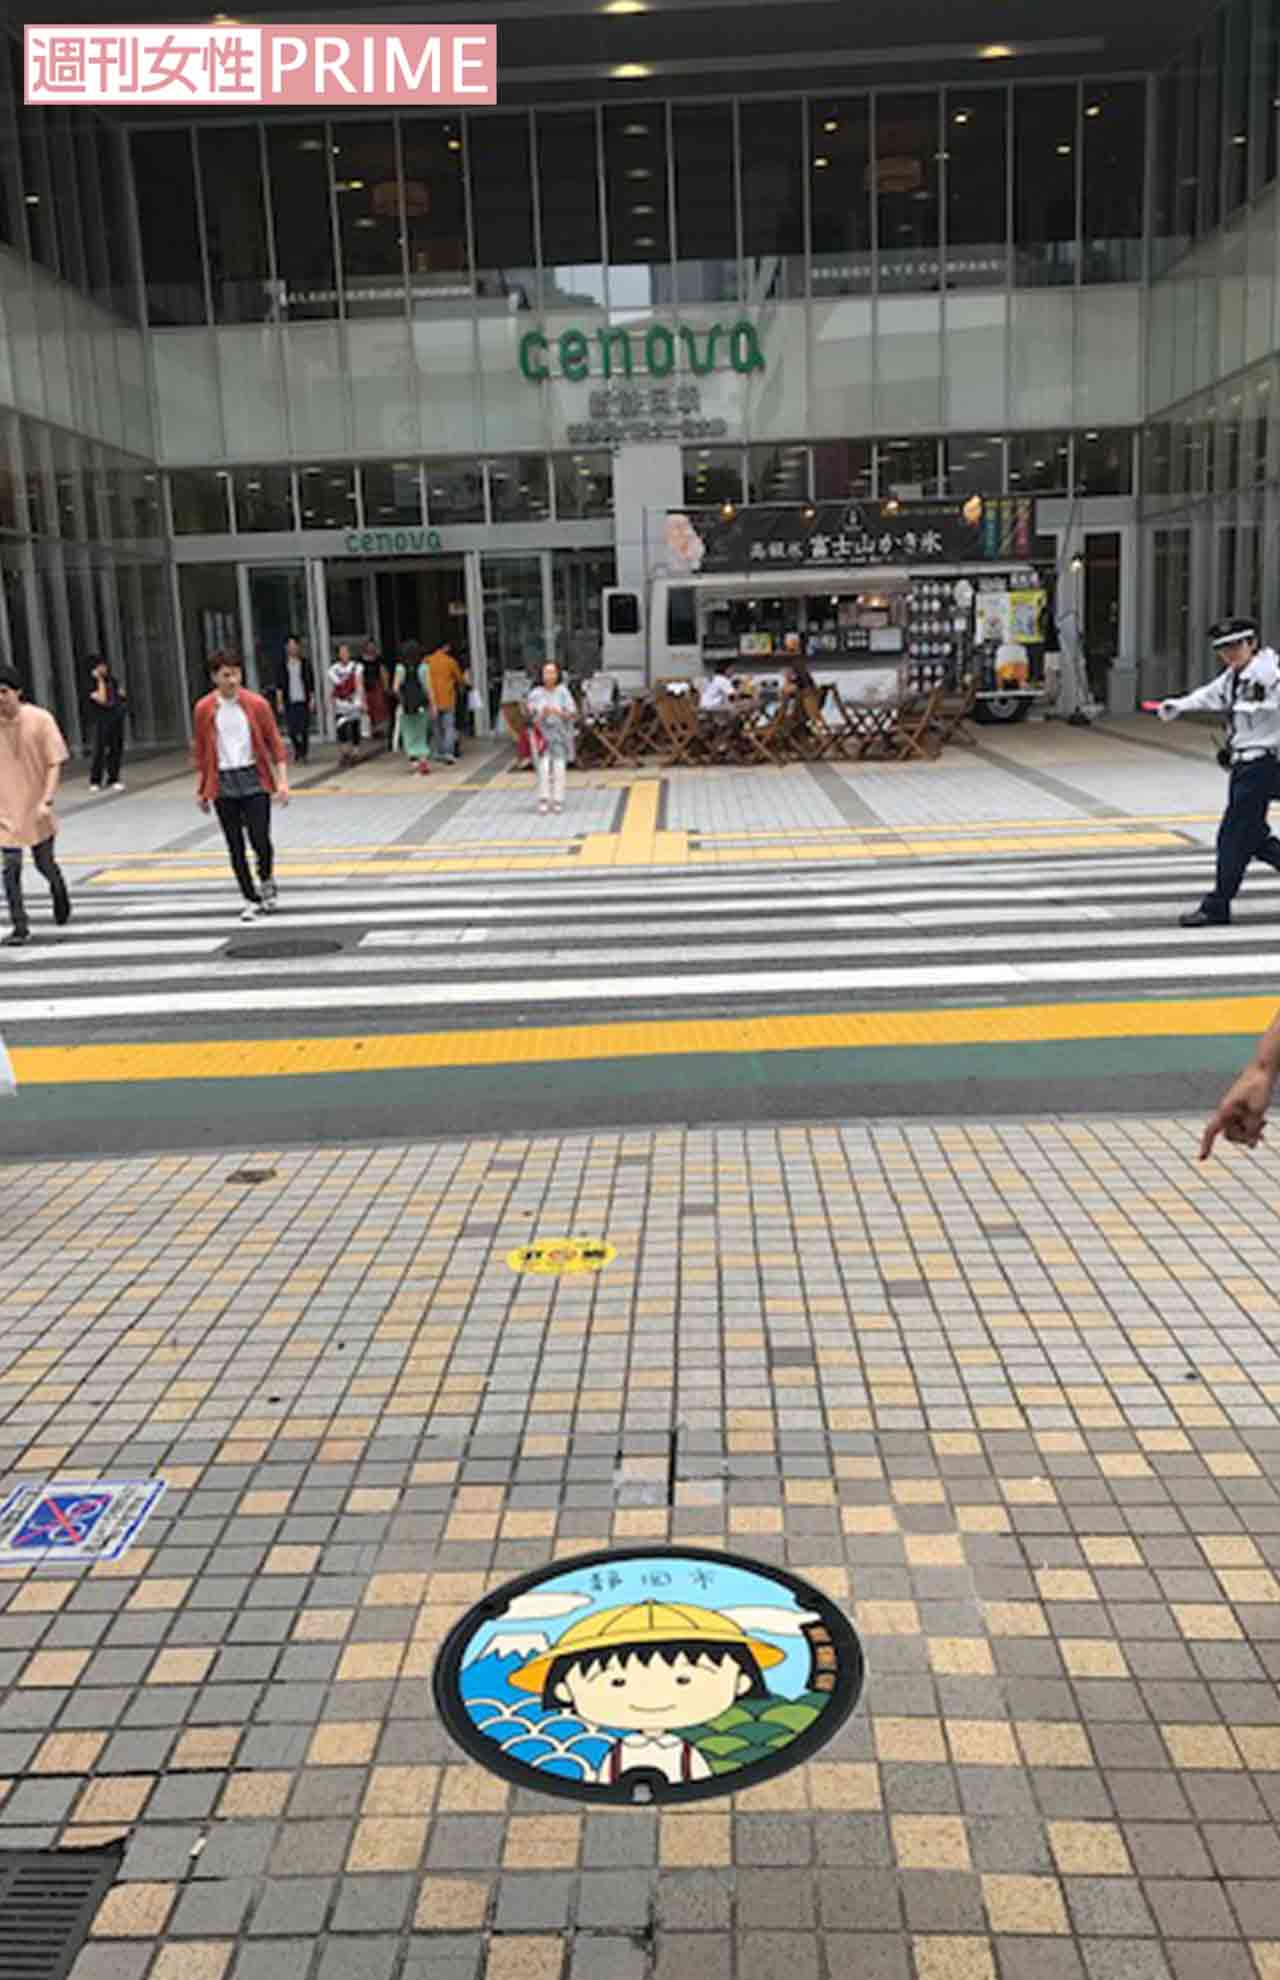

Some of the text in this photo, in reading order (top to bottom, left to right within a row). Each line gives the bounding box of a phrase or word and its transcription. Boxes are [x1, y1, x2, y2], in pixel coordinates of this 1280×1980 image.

[519, 321, 766, 382] cenova
[345, 531, 442, 553] cenova
[809, 529, 943, 558] 富士山かき氷
